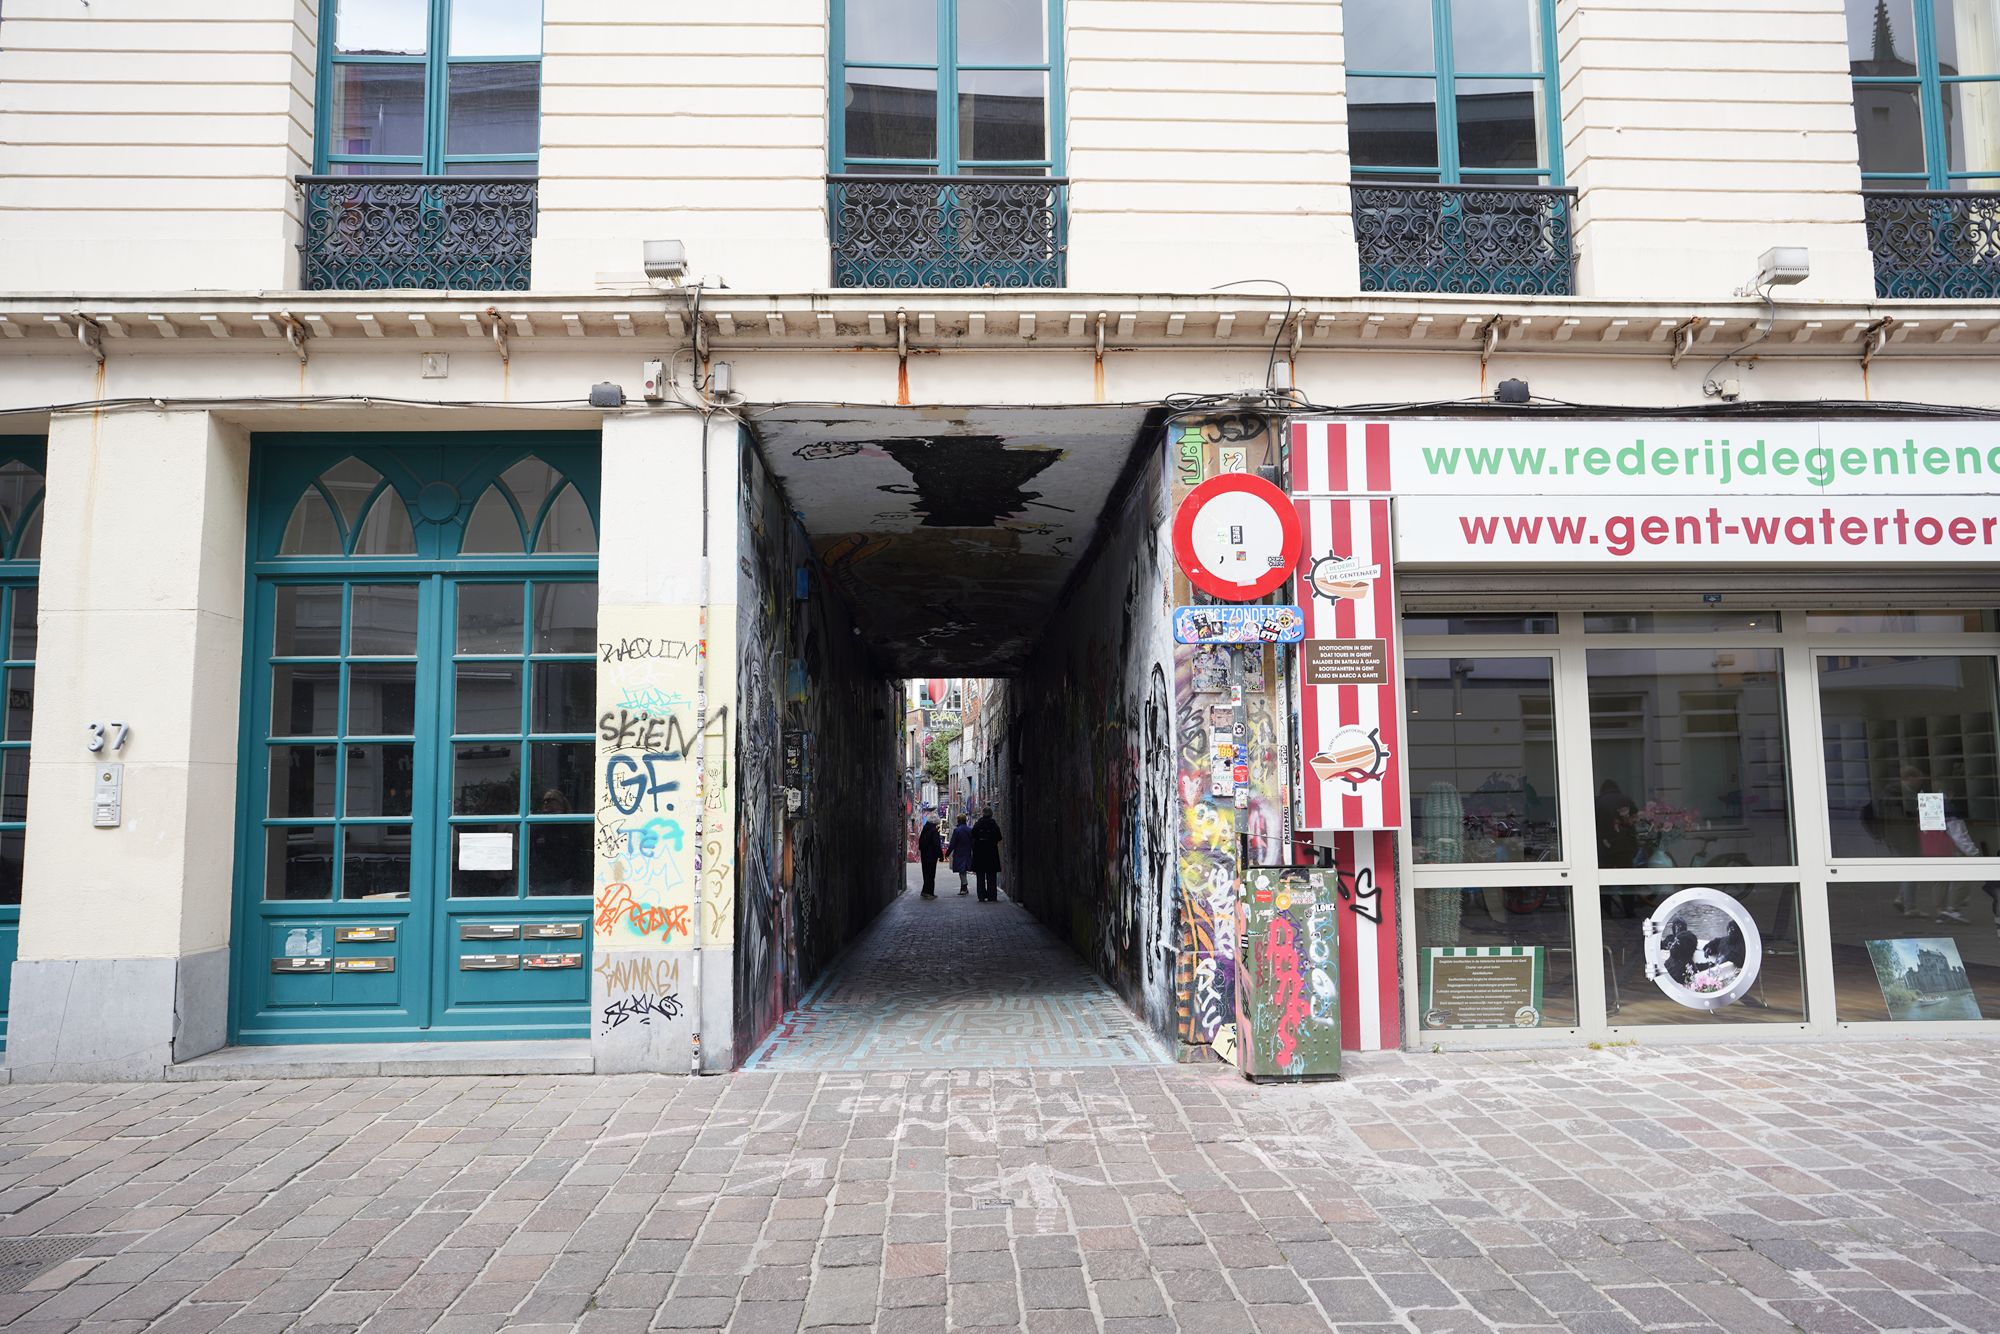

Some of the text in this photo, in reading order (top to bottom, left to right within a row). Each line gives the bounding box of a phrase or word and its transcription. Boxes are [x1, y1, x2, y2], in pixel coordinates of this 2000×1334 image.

[1459, 508, 1997, 556] www.gent-watertoer
[1340, 570, 1378, 579] GENTENAER
[85, 719, 130, 752] 37
